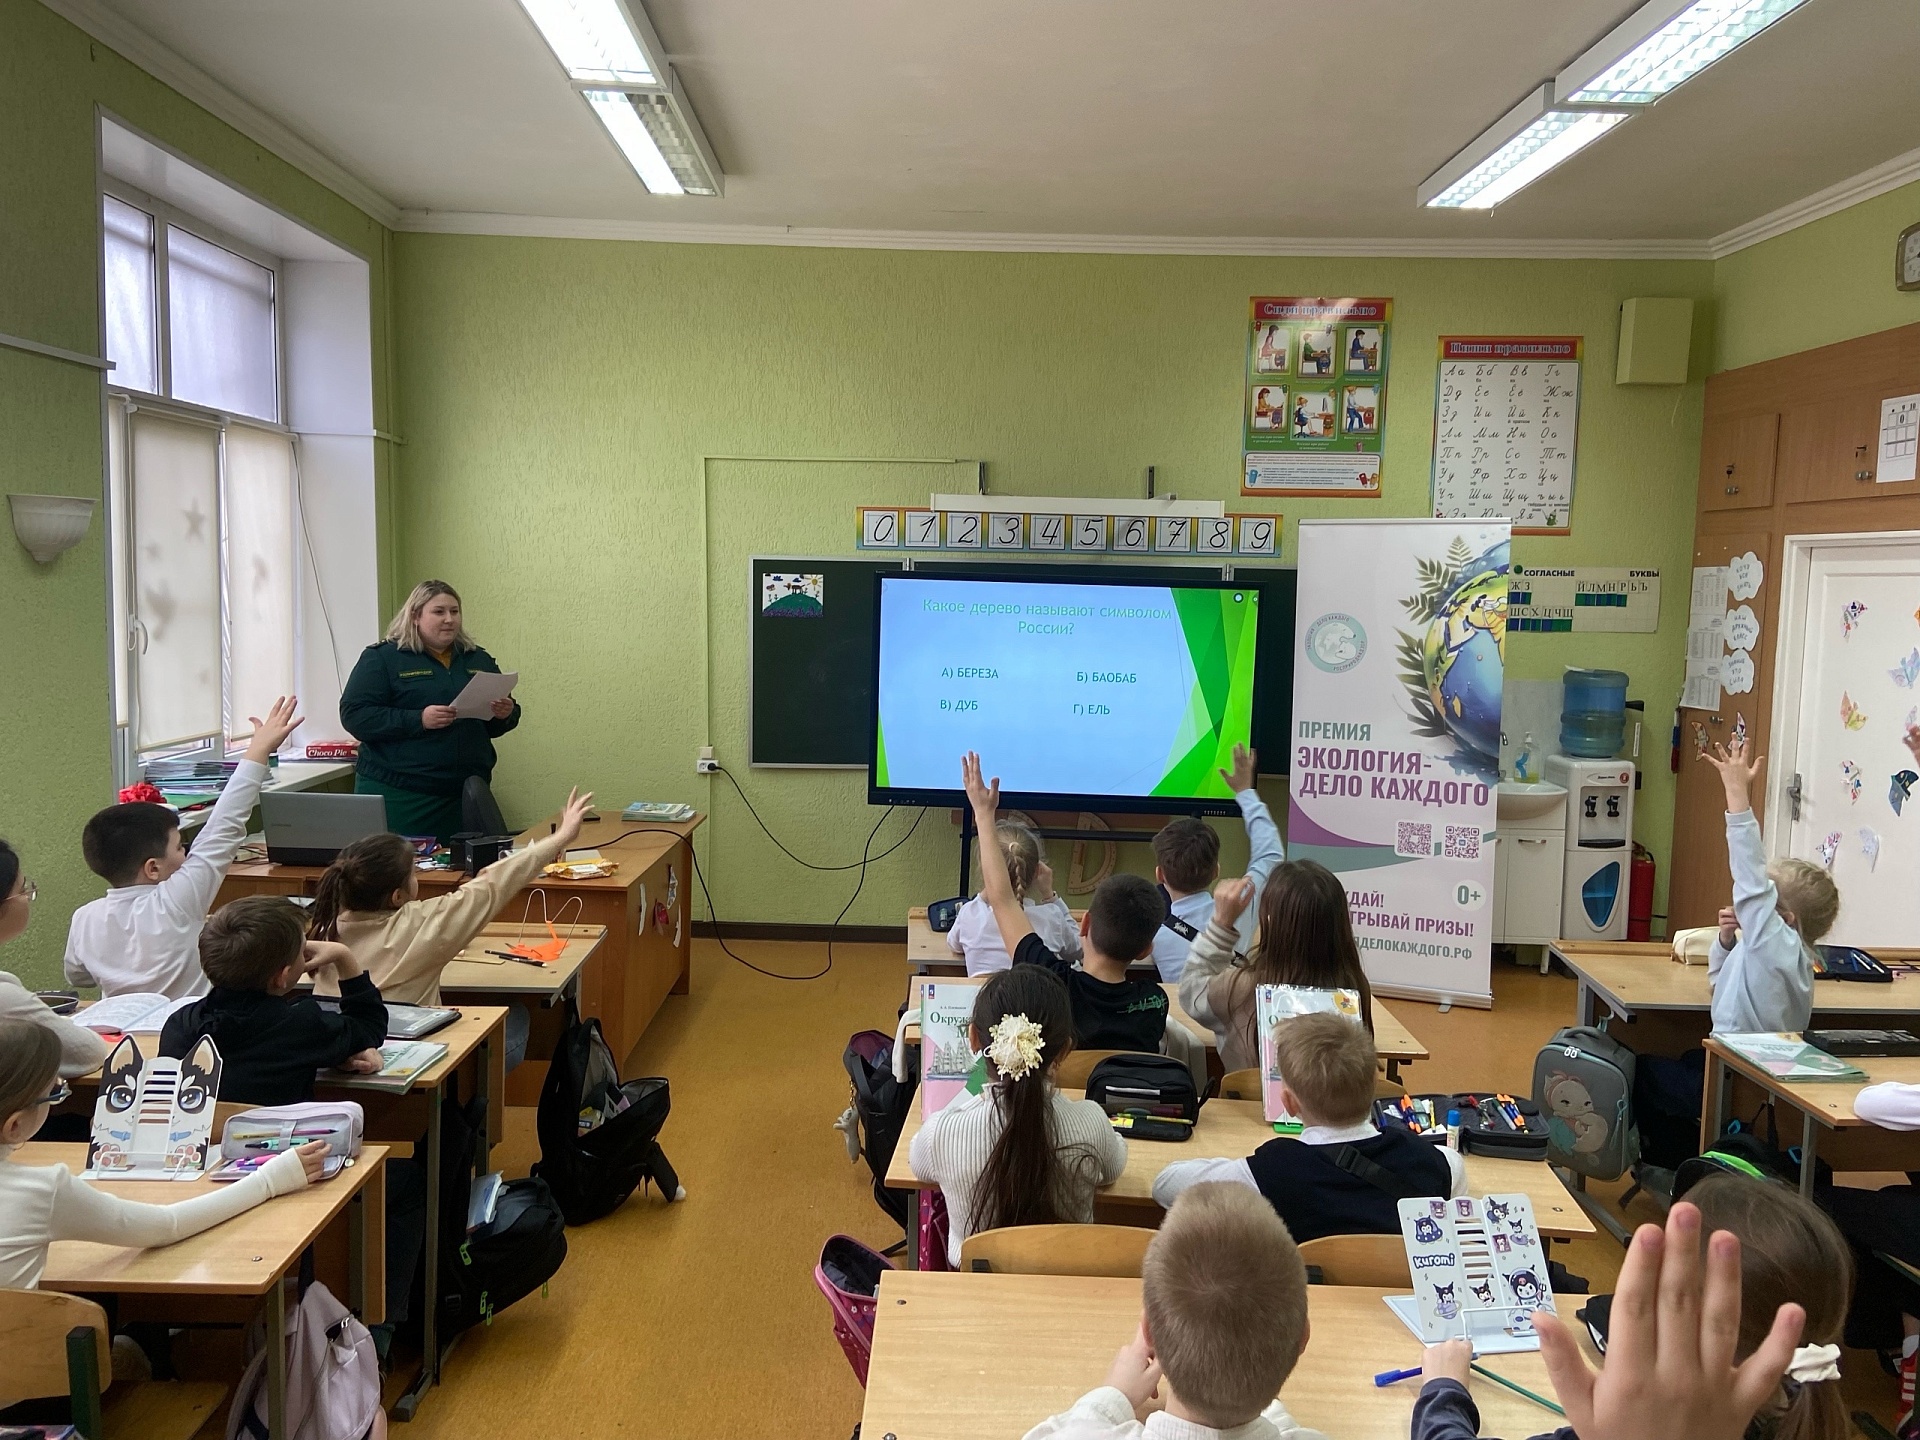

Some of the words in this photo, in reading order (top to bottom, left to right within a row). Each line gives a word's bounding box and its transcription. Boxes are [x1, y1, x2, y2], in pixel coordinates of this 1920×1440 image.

[1264, 303, 1299, 318] Сиди
[1302, 304, 1376, 317] правильно
[1450, 342, 1492, 353] Пиши
[1493, 343, 1570, 356] правильно
[874, 515, 894, 541] 0
[920, 515, 936, 542] 1
[958, 516, 977, 543] 2
[999, 517, 1019, 543] 3
[1041, 519, 1060, 544] 4
[1079, 518, 1103, 545] 5
[1125, 519, 1145, 546] 6
[1168, 520, 1187, 547] 7
[1209, 521, 1229, 548] 8
[1251, 522, 1271, 548] 9
[923, 599, 965, 613] Какое
[969, 602, 1021, 616] дерево
[1026, 605, 1095, 617] называют
[1099, 607, 1171, 619] символом
[1018, 621, 1074, 635] России?
[941, 667, 953, 679] А)
[957, 667, 999, 679] БЕРЕЗА
[1076, 671, 1088, 683] Б)
[1092, 671, 1137, 684] БАОБАБ
[940, 700, 952, 711] В)
[955, 700, 978, 712] ДУБ
[1073, 704, 1084, 716] Г)
[1088, 704, 1111, 715] ЕЛЬ
[1299, 721, 1371, 741] ПРЕМИЯ
[308, 749, 332, 757] Choco
[333, 749, 347, 757] Pie
[1299, 772, 1362, 799] ДЕЛО
[1371, 776, 1489, 807] КАЖДОГО
[1457, 885, 1481, 905] 0+
[1415, 917, 1474, 938] ПРИЗЫ!
